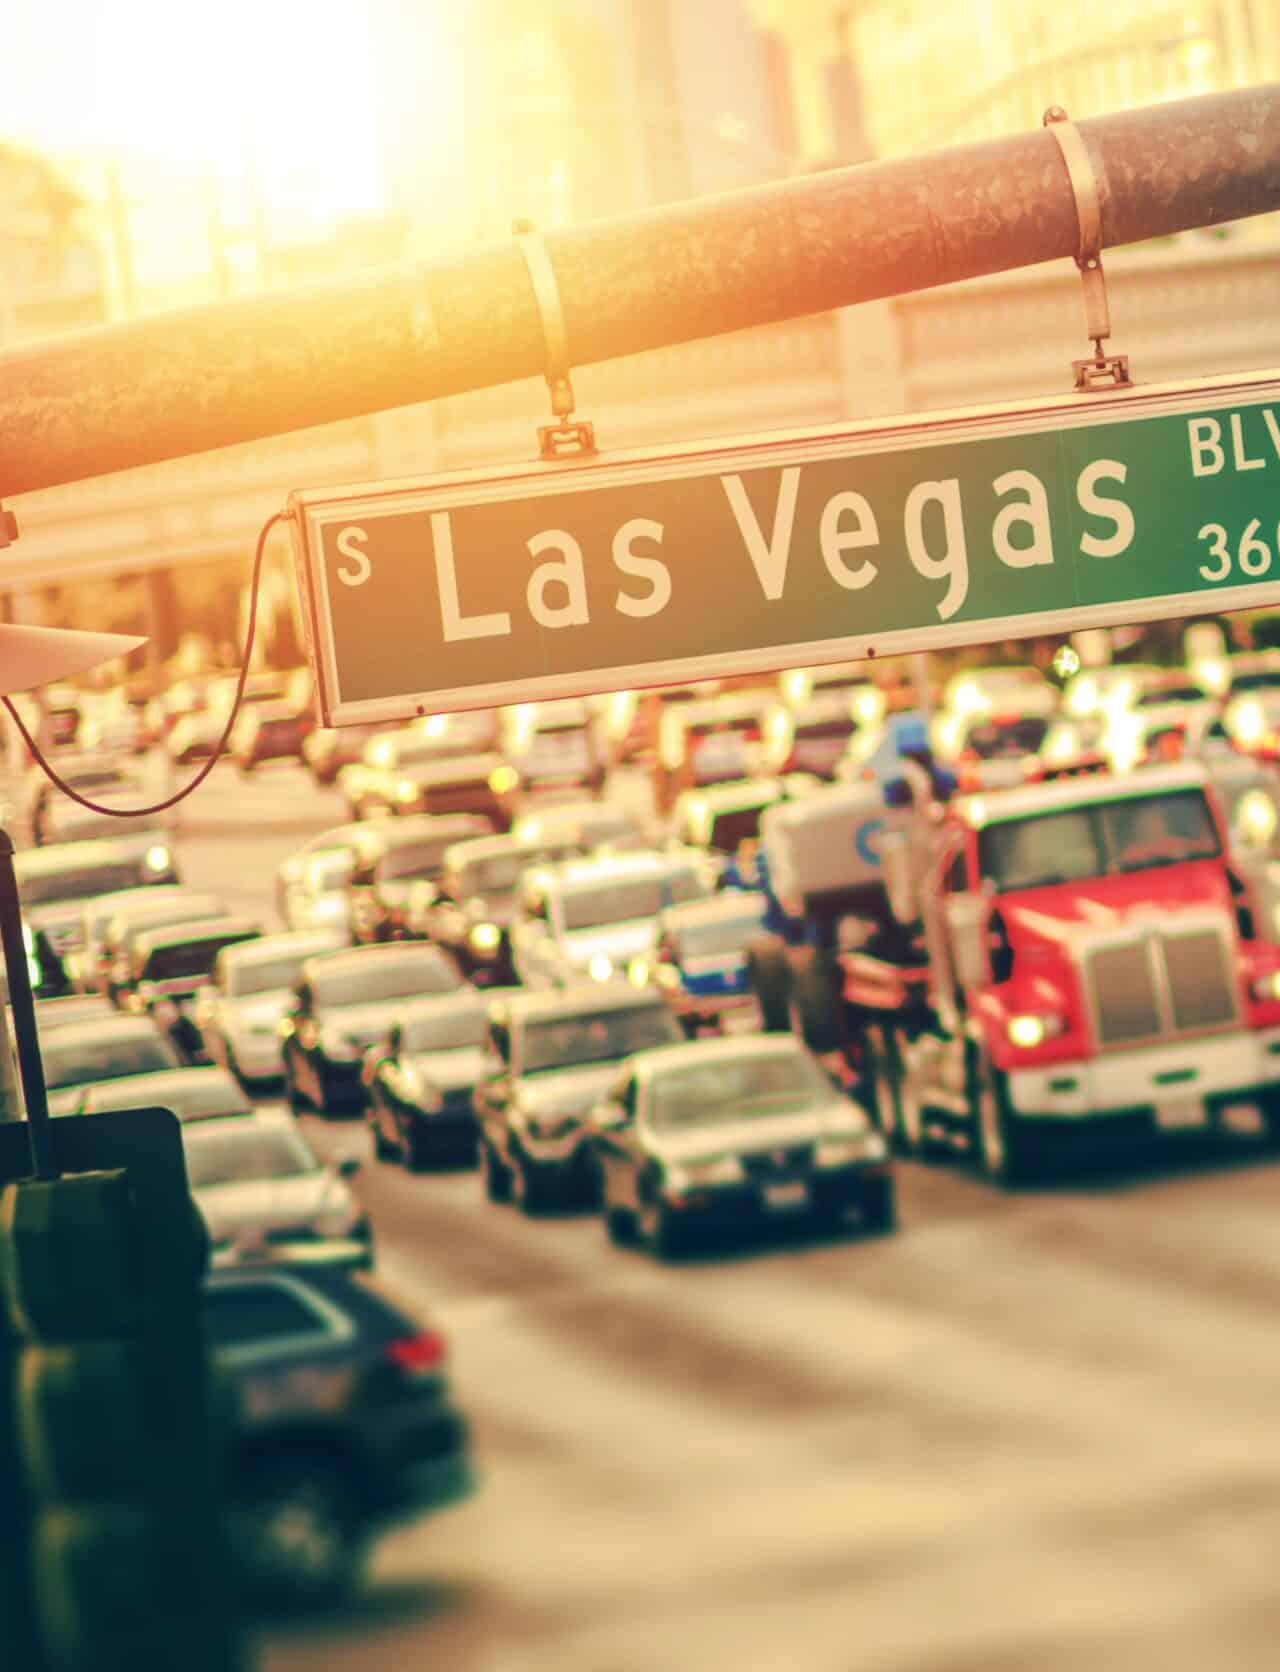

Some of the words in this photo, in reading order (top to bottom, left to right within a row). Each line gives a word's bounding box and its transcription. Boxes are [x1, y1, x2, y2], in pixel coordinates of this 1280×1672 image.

[336, 525, 371, 586] S
[431, 512, 672, 641] Las
[722, 458, 1135, 620] Vegas
